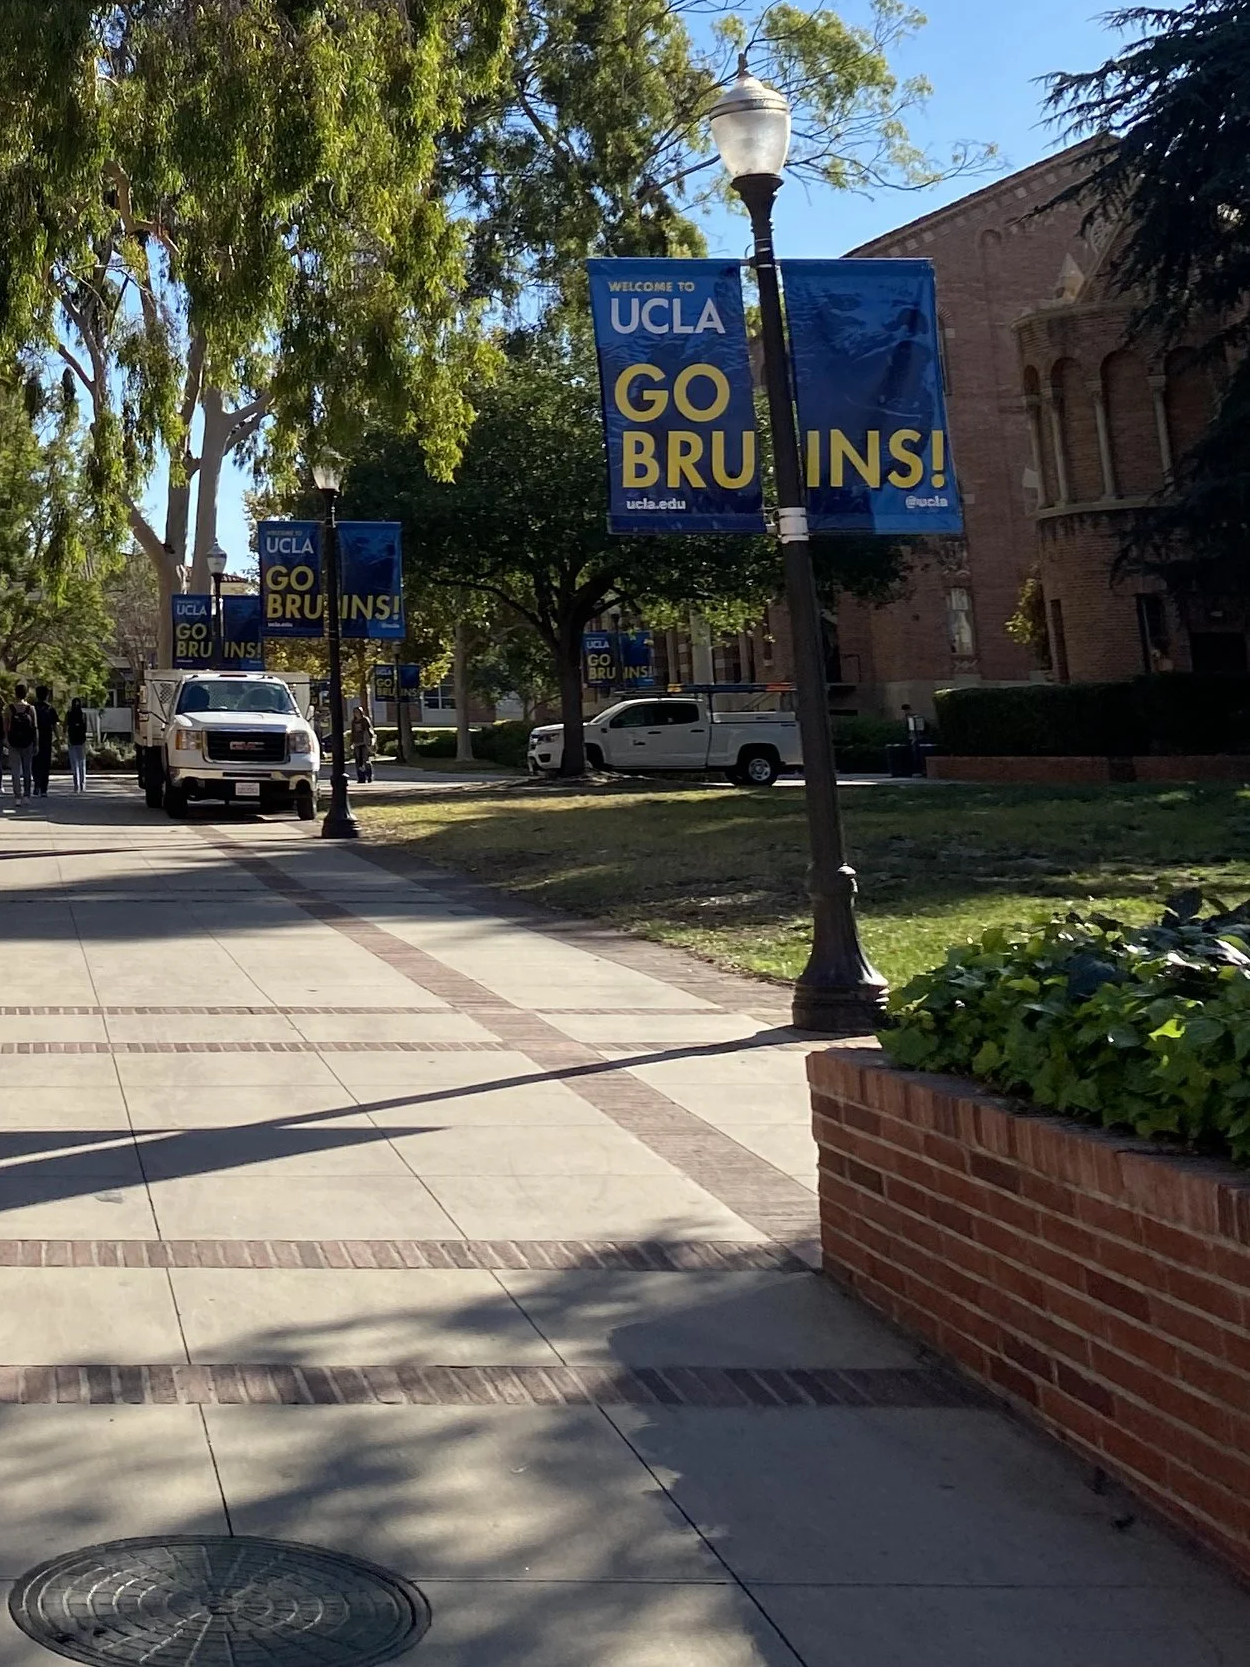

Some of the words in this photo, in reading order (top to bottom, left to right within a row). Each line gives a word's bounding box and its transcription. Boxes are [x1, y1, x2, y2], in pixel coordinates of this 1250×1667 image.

[608, 281, 673, 292] WELCOME
[678, 281, 695, 292] TO
[610, 297, 726, 335] UCLA
[614, 363, 731, 423] GO
[626, 497, 686, 510] ucla.edu
[266, 537, 314, 554] UCLA
[265, 565, 314, 591] GO
[176, 604, 207, 616] UCLA
[176, 623, 207, 640] GO
[586, 640, 610, 649] UCLA
[588, 654, 611, 666] GO
